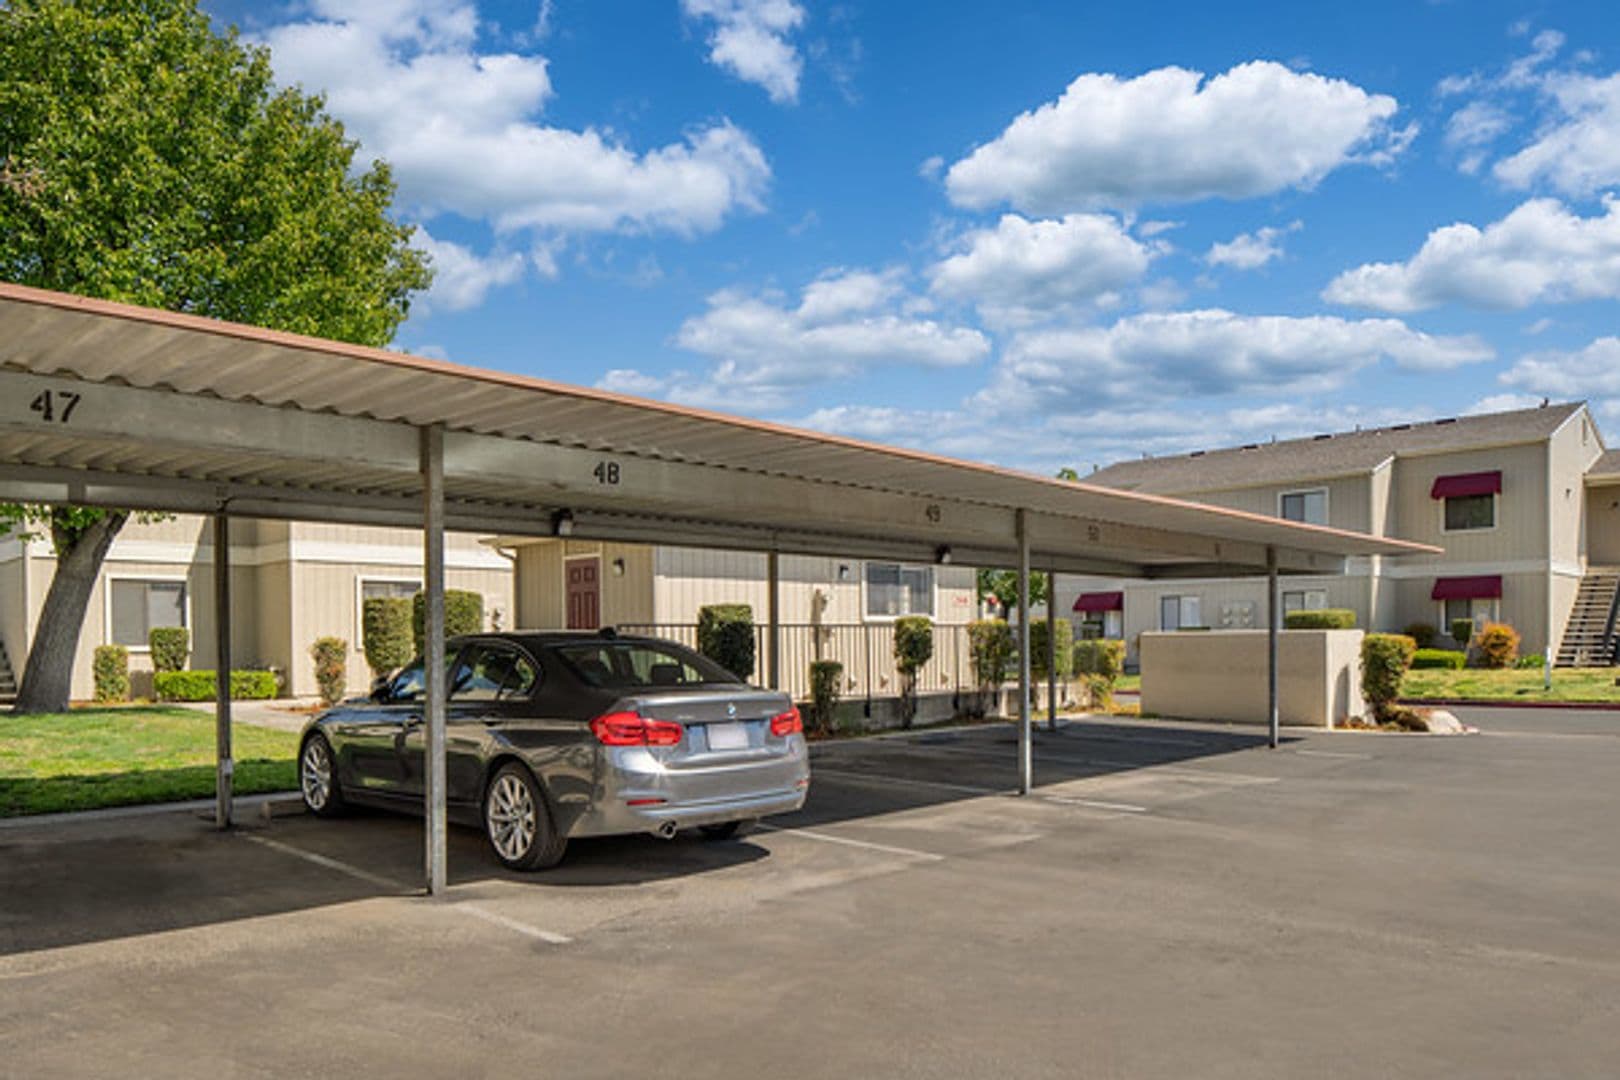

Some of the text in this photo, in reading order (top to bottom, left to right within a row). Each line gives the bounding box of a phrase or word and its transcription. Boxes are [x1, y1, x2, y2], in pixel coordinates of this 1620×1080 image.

[30, 390, 80, 422] 47
[593, 461, 620, 484] 48
[925, 504, 941, 522] 49
